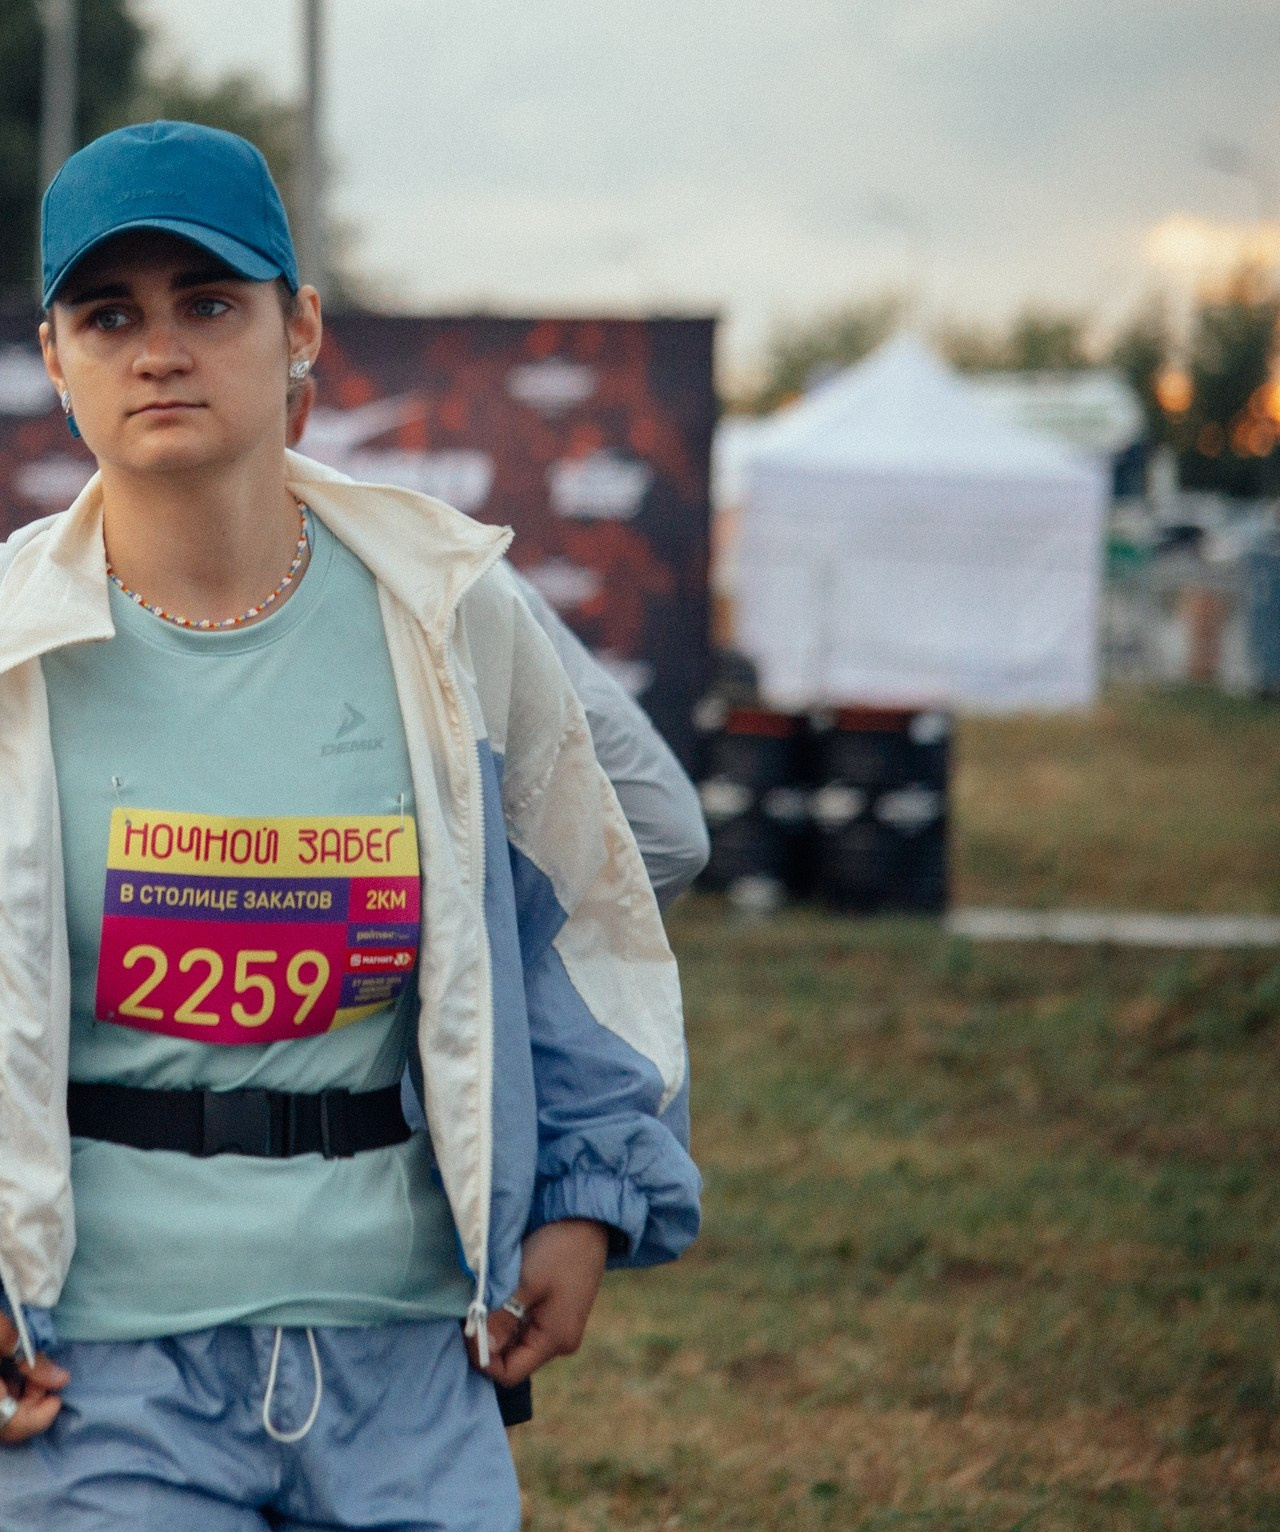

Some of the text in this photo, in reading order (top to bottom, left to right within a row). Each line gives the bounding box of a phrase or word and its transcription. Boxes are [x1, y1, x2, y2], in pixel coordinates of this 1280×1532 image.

[124, 823, 404, 865] НОЧНОЙ ЗАБЕГ
[120, 883, 332, 912] В СТОЛИЦЕ ЗАКАТОВ
[365, 889, 407, 911] 2КМ
[118, 944, 331, 1028] 2259
